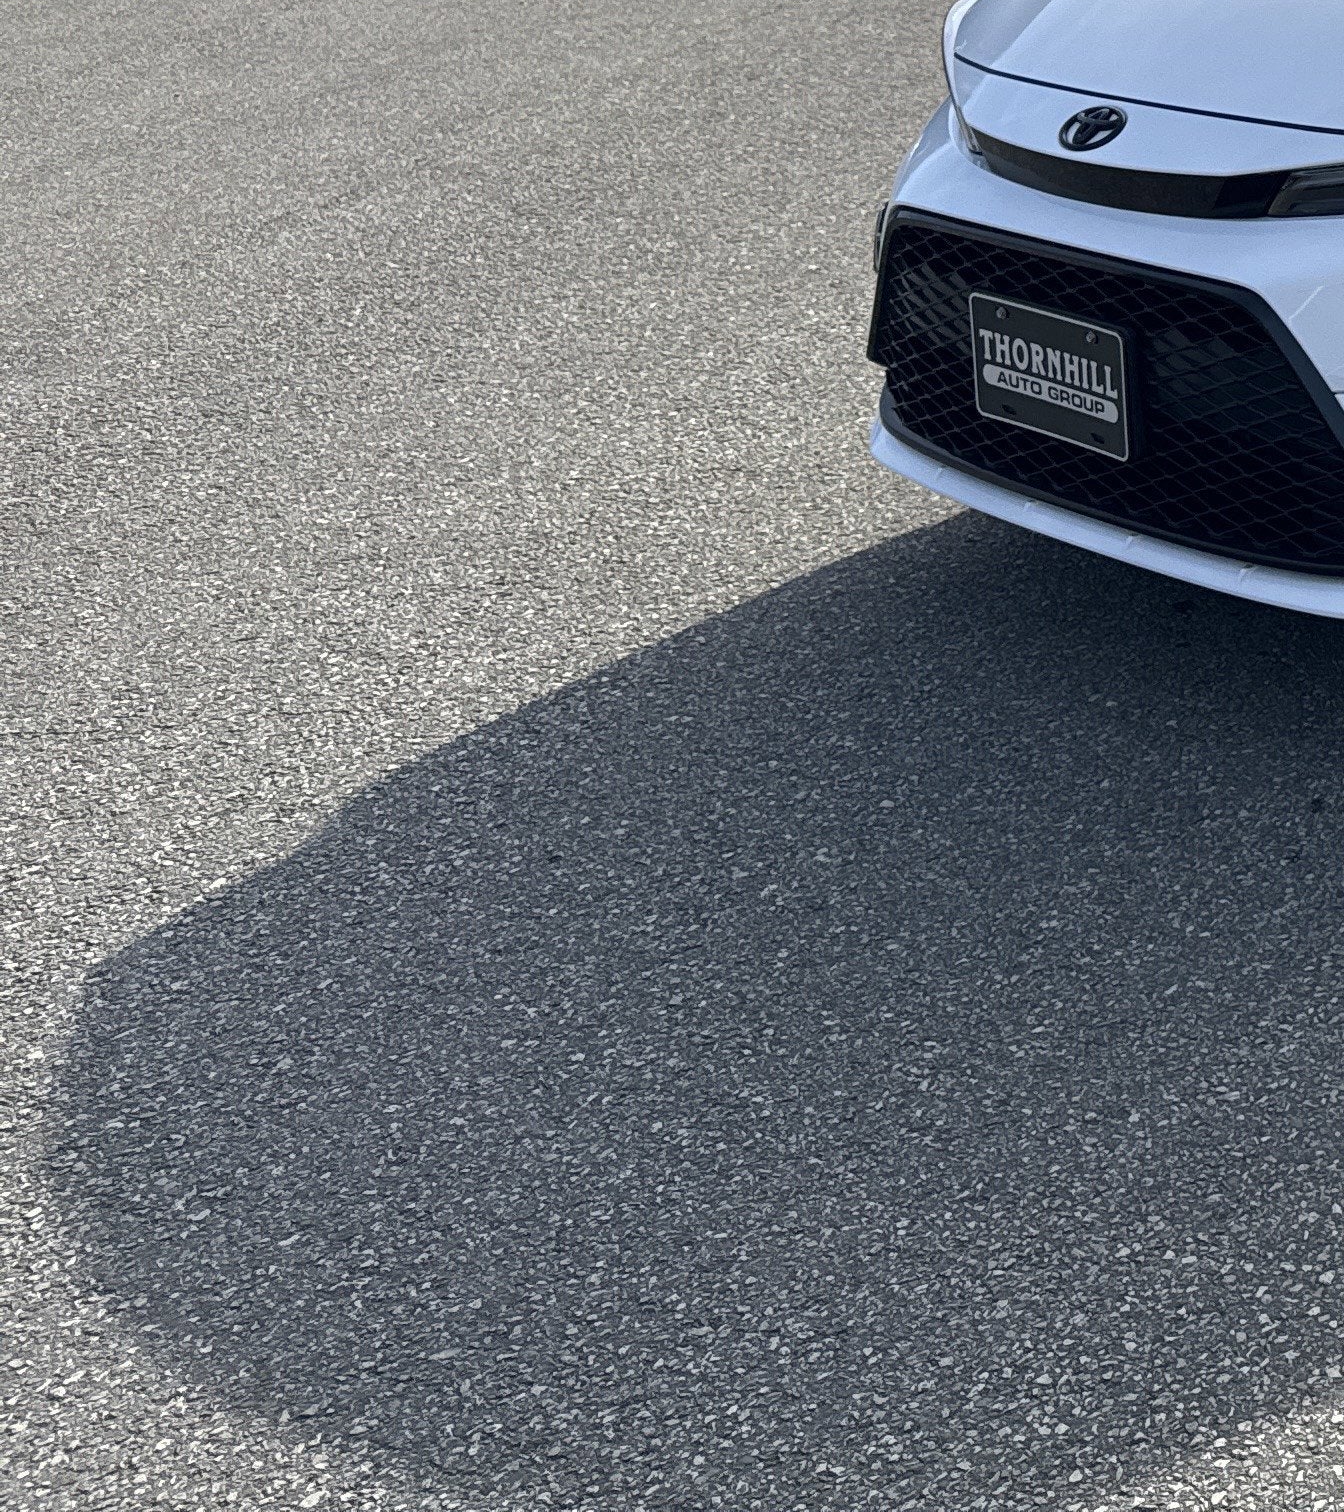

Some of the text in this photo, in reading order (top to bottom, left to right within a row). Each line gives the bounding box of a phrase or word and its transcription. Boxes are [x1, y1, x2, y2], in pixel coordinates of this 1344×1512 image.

[978, 328, 1118, 399] THORNHILL
[997, 370, 1105, 415] AUTO GROUP
